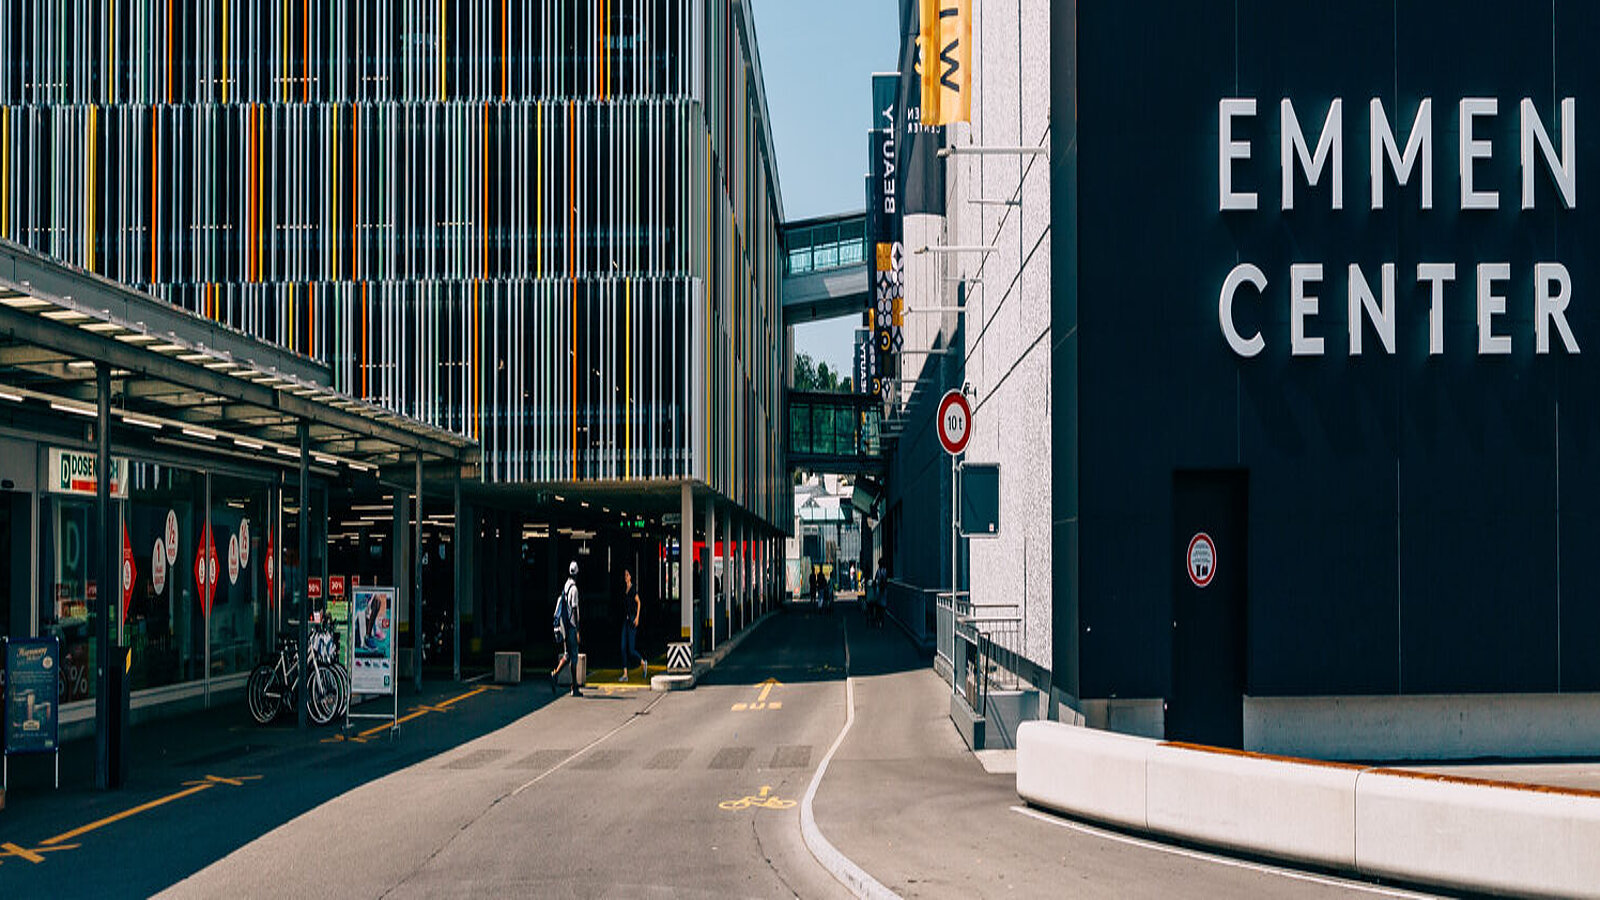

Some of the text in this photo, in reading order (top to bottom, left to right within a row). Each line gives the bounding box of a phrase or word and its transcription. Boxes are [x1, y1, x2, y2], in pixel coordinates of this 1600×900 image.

[1219, 97, 1576, 211] EMMEN
[1219, 262, 1581, 357] CENTER
[948, 415, 963, 431] 10 t
